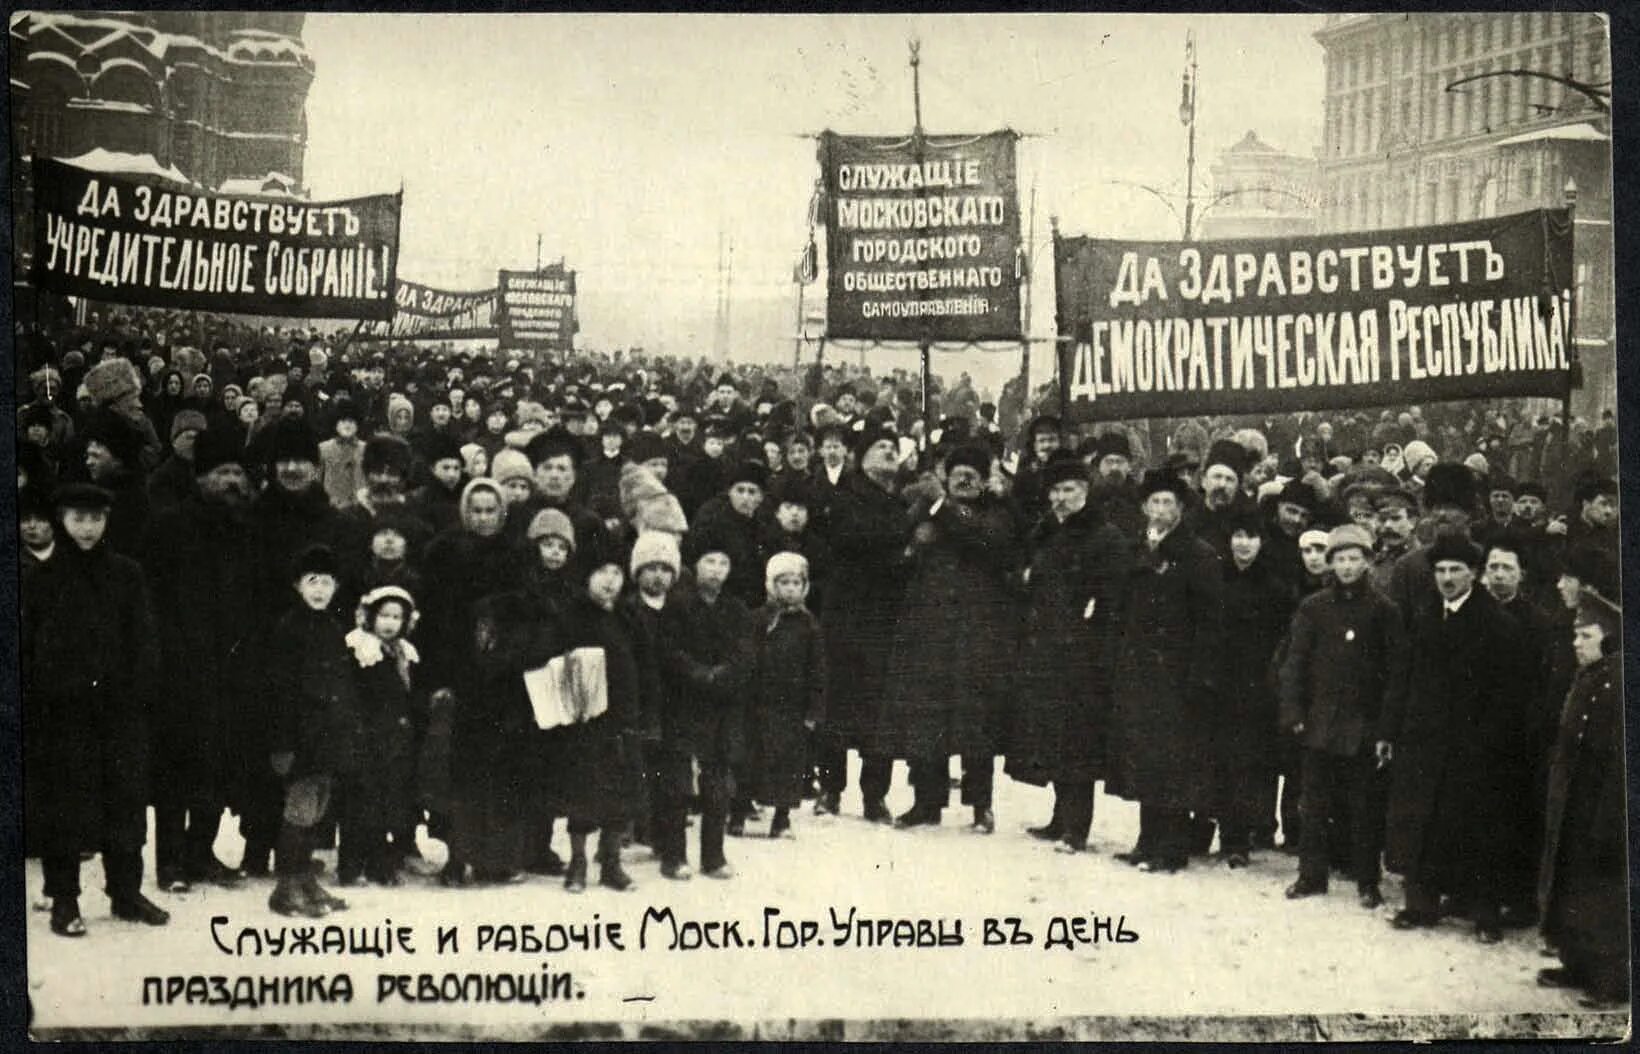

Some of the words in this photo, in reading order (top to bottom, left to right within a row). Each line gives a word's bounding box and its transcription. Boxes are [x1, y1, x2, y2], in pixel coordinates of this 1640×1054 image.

[839, 155, 981, 190] СЛУЖАЩІЕ
[78, 180, 120, 217] ДА
[134, 185, 360, 237] ЗДРАВСТВУЕТЪ
[838, 195, 1004, 229] МОСКОВСКАГО
[46, 211, 258, 293] УЧРЕДИТЕЛЬНОЕ
[264, 239, 389, 299] СОБРАНІЕ!
[853, 236, 981, 263] ГОРОДСКОГО
[843, 267, 1002, 292] ОБЩЕСТВЕННАГО
[1110, 252, 1169, 307] ДА
[1179, 240, 1505, 304] ЗДРАВСТВУЕТЪ
[1069, 307, 1379, 402] ДЕМОКРАТИЧЕСКАЯ
